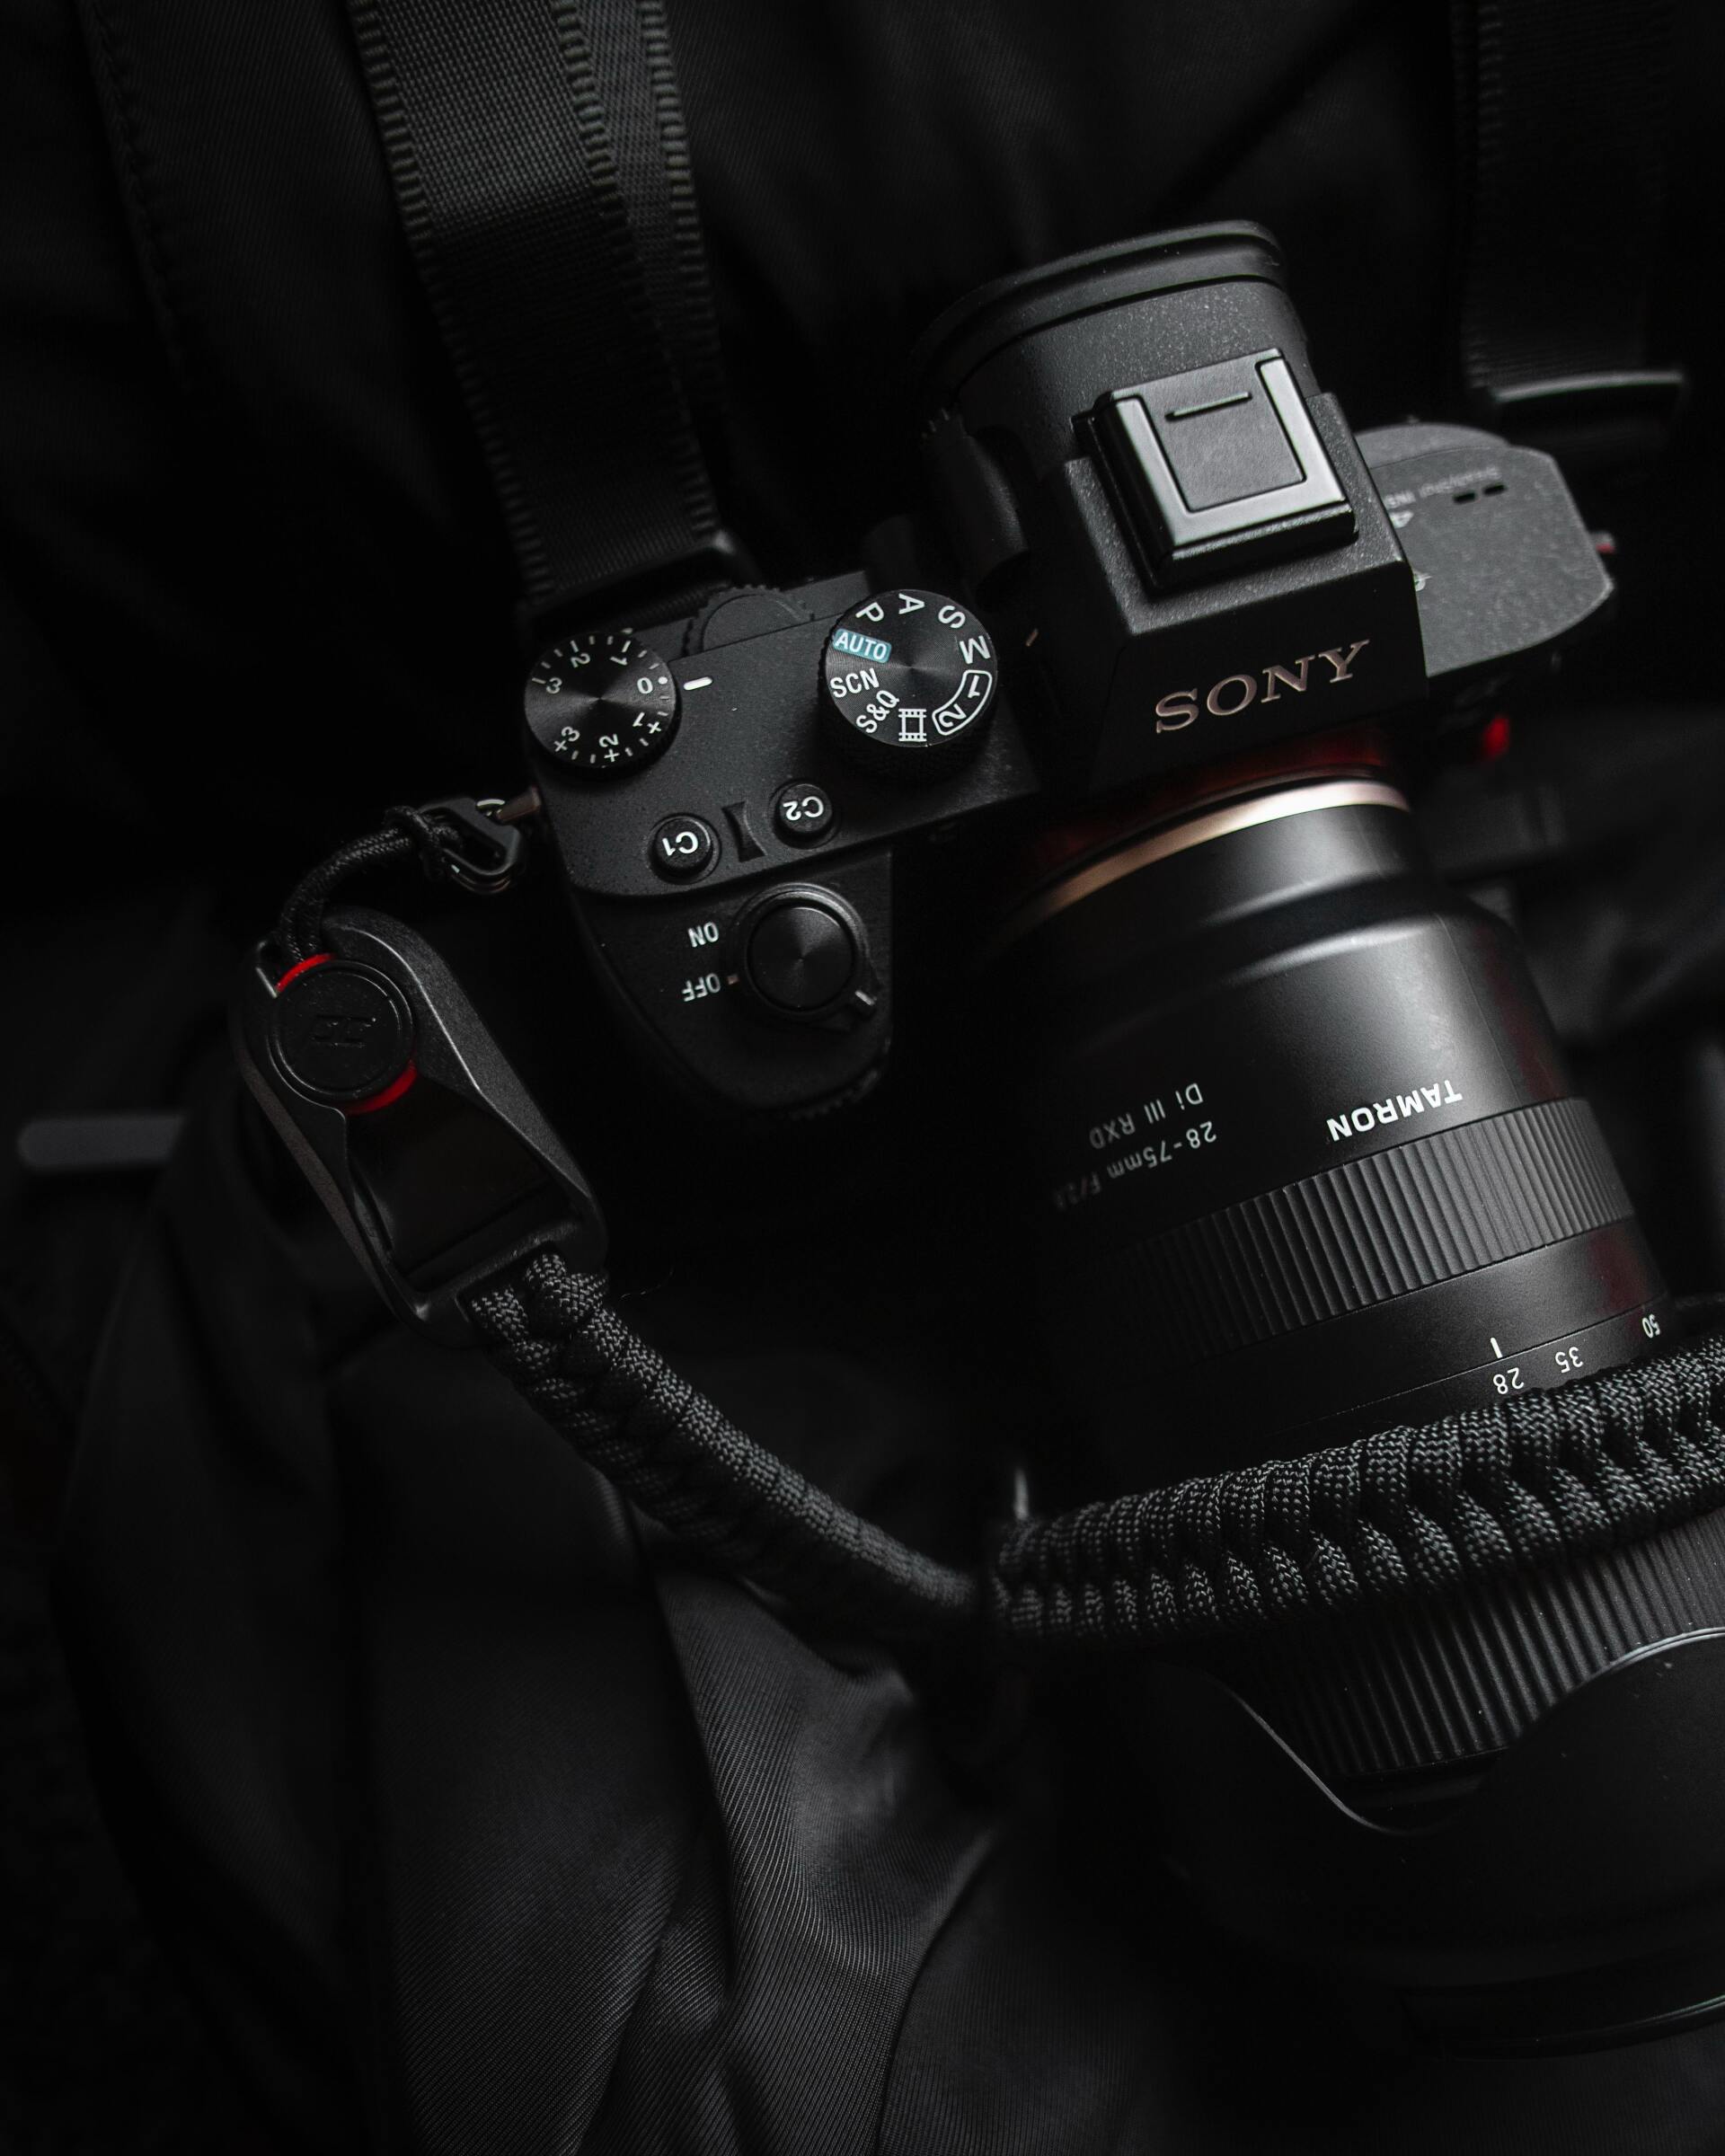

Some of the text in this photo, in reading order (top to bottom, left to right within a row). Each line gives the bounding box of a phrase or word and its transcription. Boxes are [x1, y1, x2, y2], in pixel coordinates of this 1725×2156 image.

[855, 602, 884, 623] P
[898, 593, 925, 614] A
[938, 605, 966, 629] S
[835, 632, 887, 660] AUTO
[959, 635, 991, 665] M
[637, 677, 653, 694] 0
[830, 667, 880, 698] SCN
[968, 675, 980, 698] 1
[1154, 639, 1371, 734] SONY
[855, 690, 899, 733] S&Q
[939, 703, 967, 728] 2
[783, 796, 824, 821] C2
[662, 831, 699, 856] C1
[688, 922, 719, 948] ON
[682, 973, 721, 1003] OFF
[1174, 1082, 1204, 1111] Di
[1326, 1080, 1464, 1142] TAMRON
[1089, 1112, 1136, 1149] RXD
[1106, 1120, 1217, 1179] 28-75mm
[1641, 1313, 1661, 1339] 50
[1554, 1347, 1583, 1373] 35
[1492, 1367, 1525, 1394] 28
